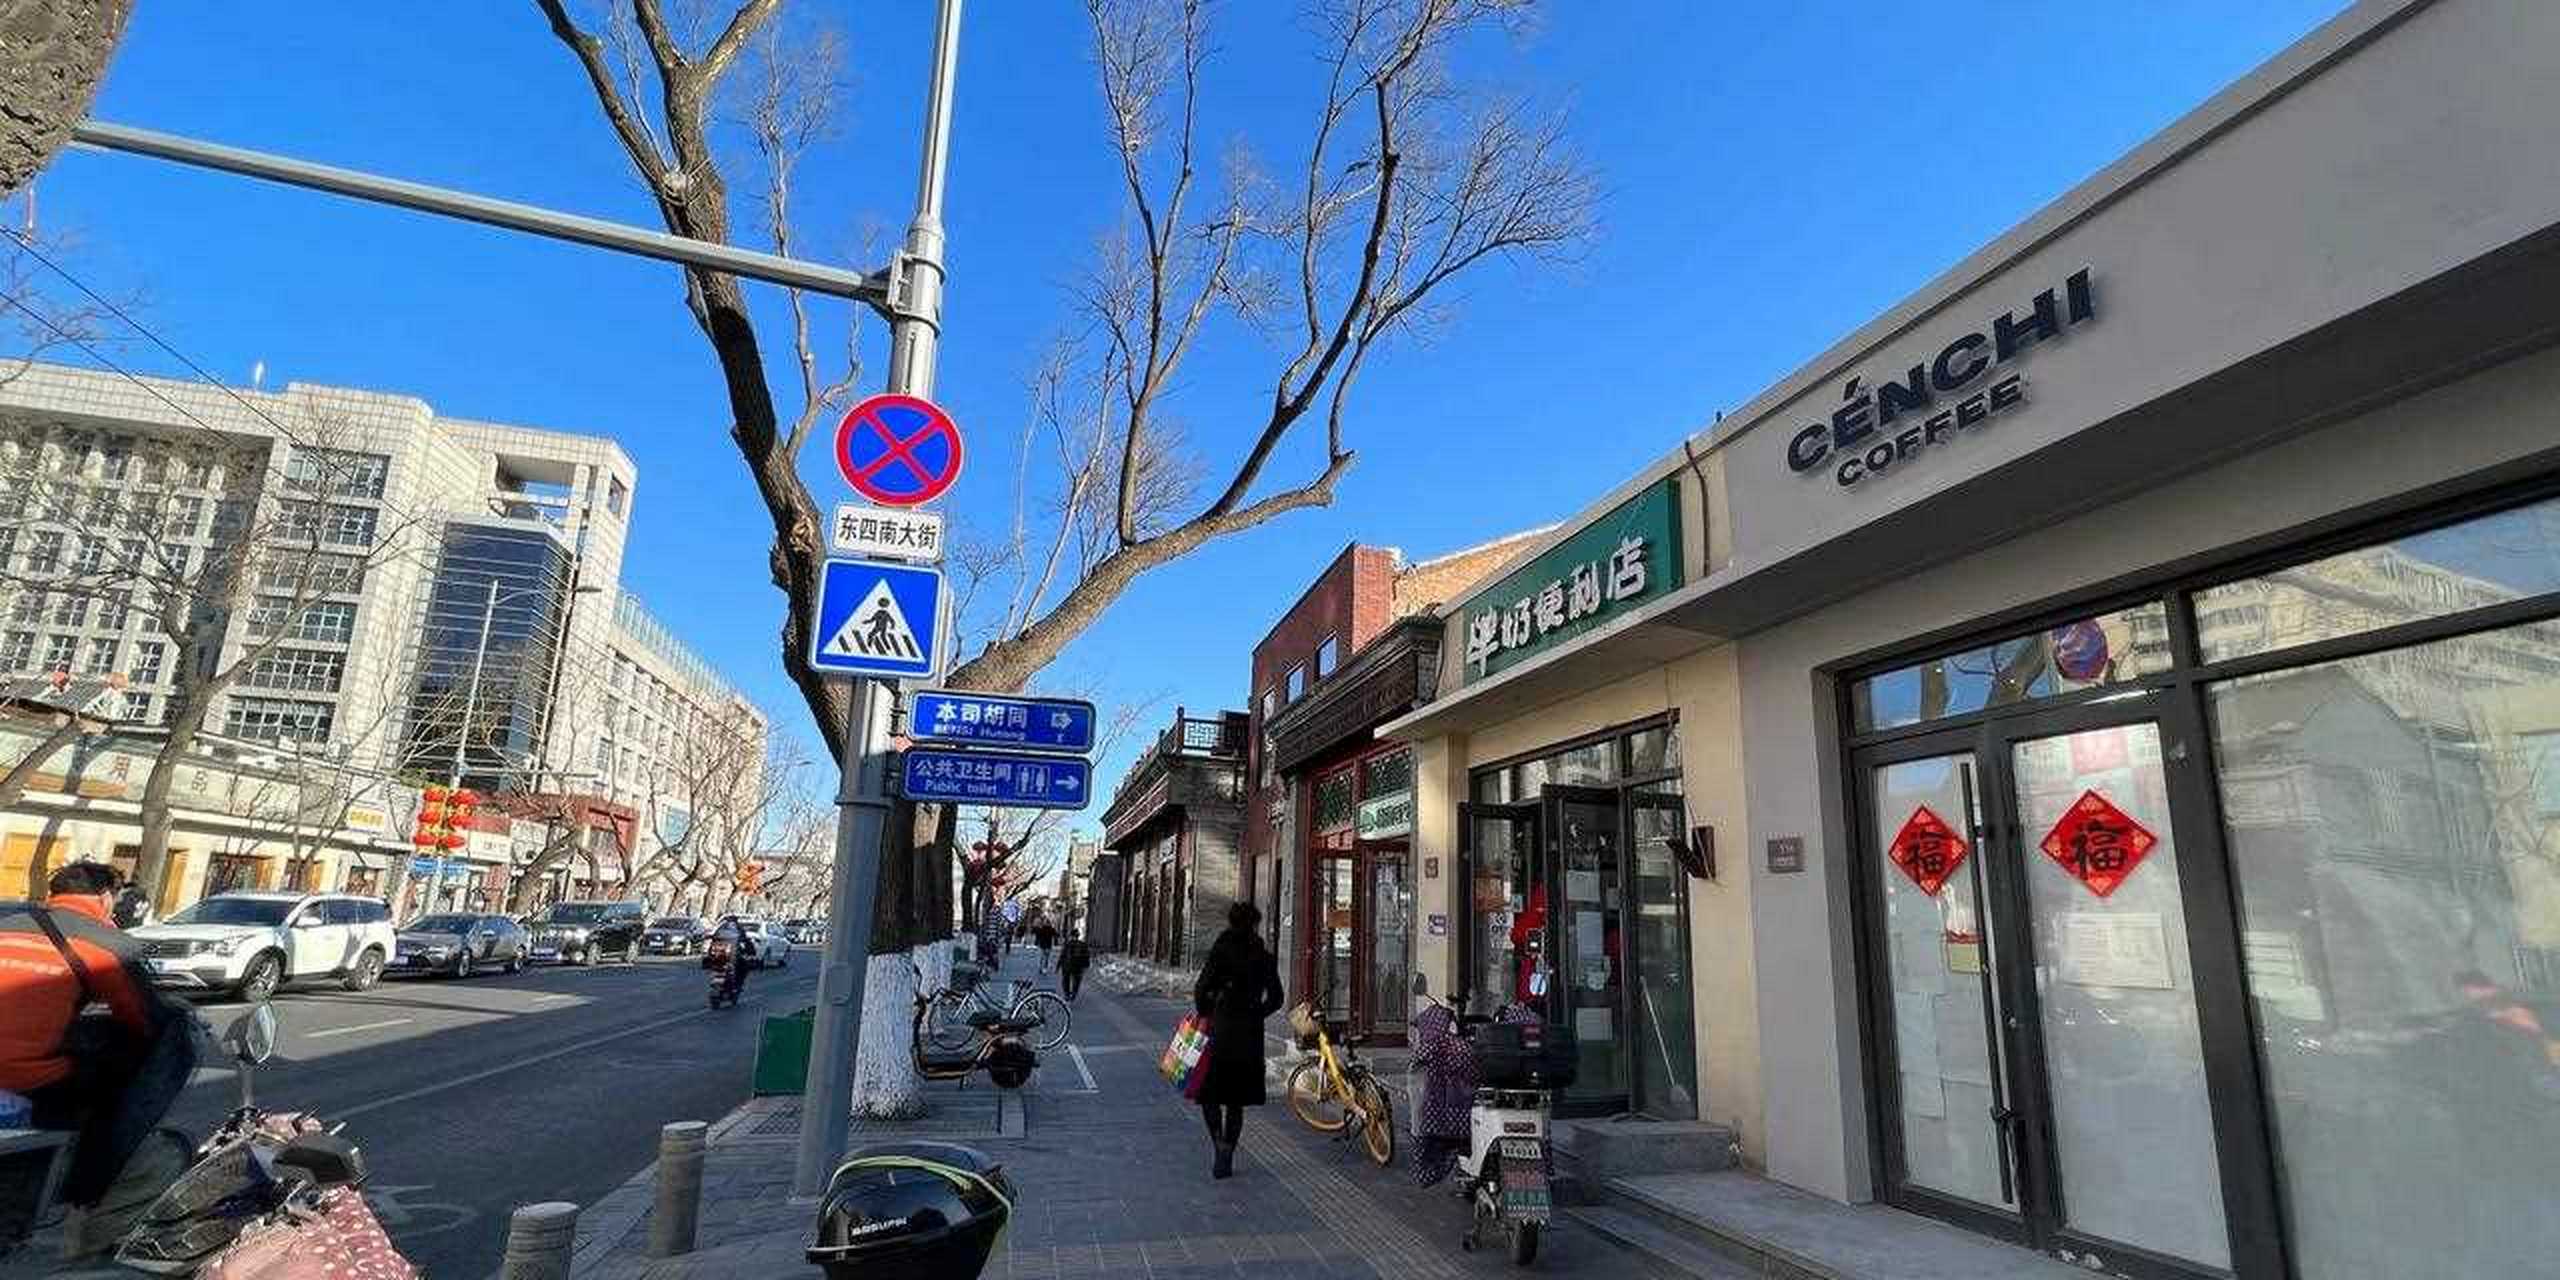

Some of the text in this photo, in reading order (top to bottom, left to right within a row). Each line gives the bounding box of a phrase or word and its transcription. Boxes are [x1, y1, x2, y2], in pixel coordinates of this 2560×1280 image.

[1788, 266, 2092, 471] CÉNCHI
[1838, 373, 2023, 486] COFFEE
[839, 514, 937, 549] 东四南大街
[935, 701, 1028, 729] 本司胡同
[915, 759, 1013, 782] 公共卫生间
[924, 779, 998, 796] Public toilet
[1904, 829, 1947, 882] 福
[2073, 818, 2128, 881] 福
